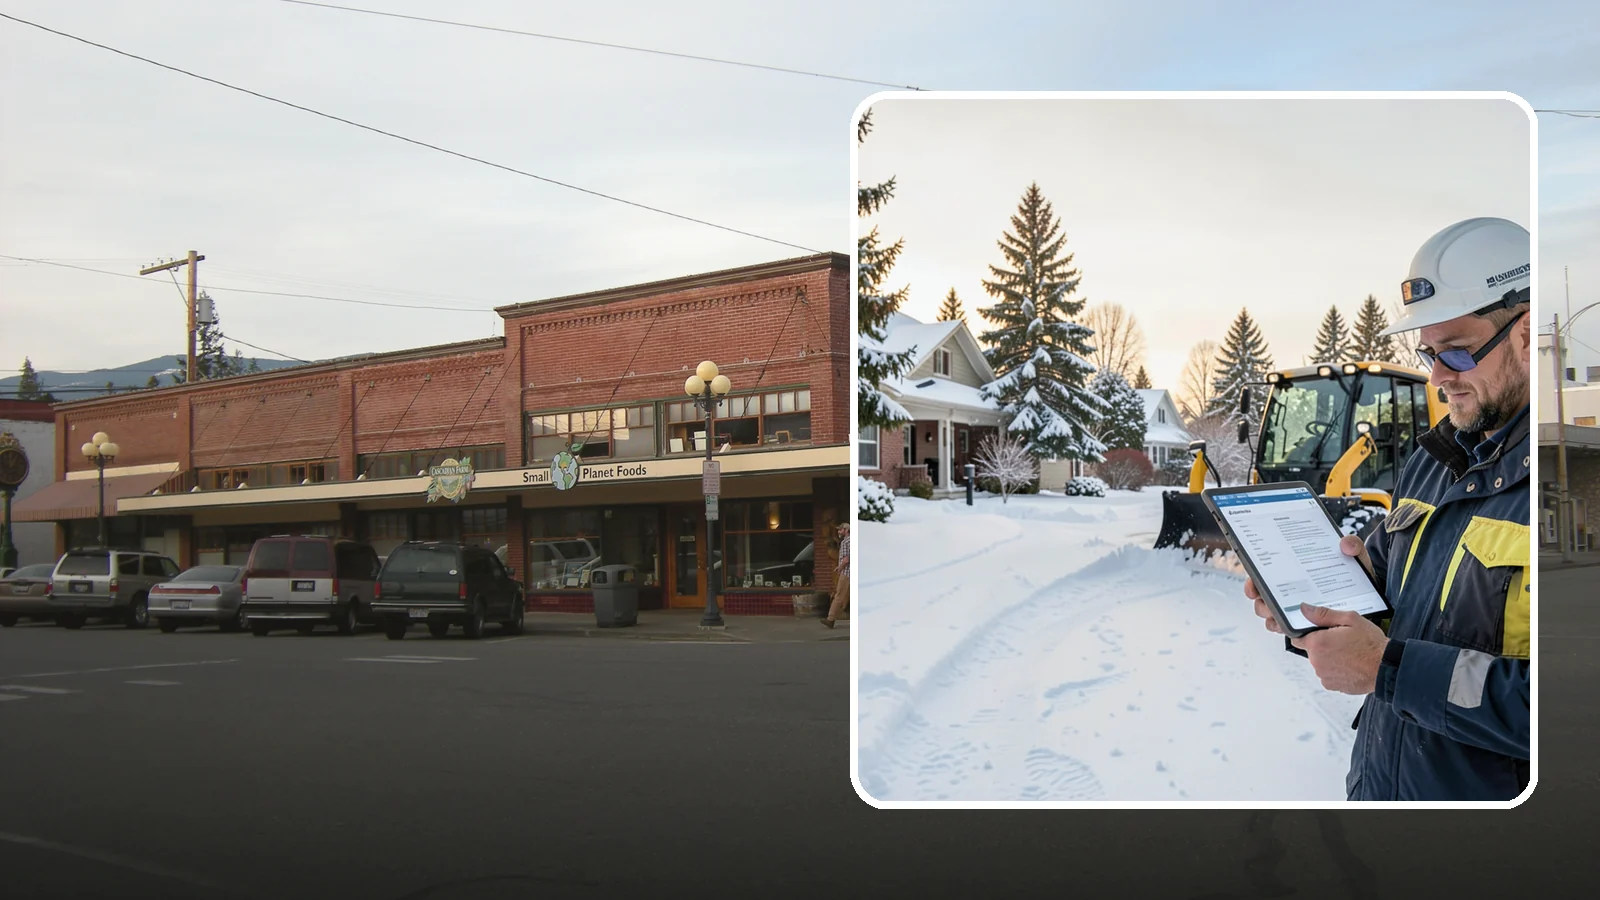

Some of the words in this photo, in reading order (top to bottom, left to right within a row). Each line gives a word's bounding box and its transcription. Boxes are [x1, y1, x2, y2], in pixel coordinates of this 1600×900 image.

[431, 466, 456, 475] CASCADIAN
[456, 465, 469, 474] FARM
[523, 471, 549, 483] Small
[583, 467, 614, 479] Planet
[616, 464, 647, 477] Foods
